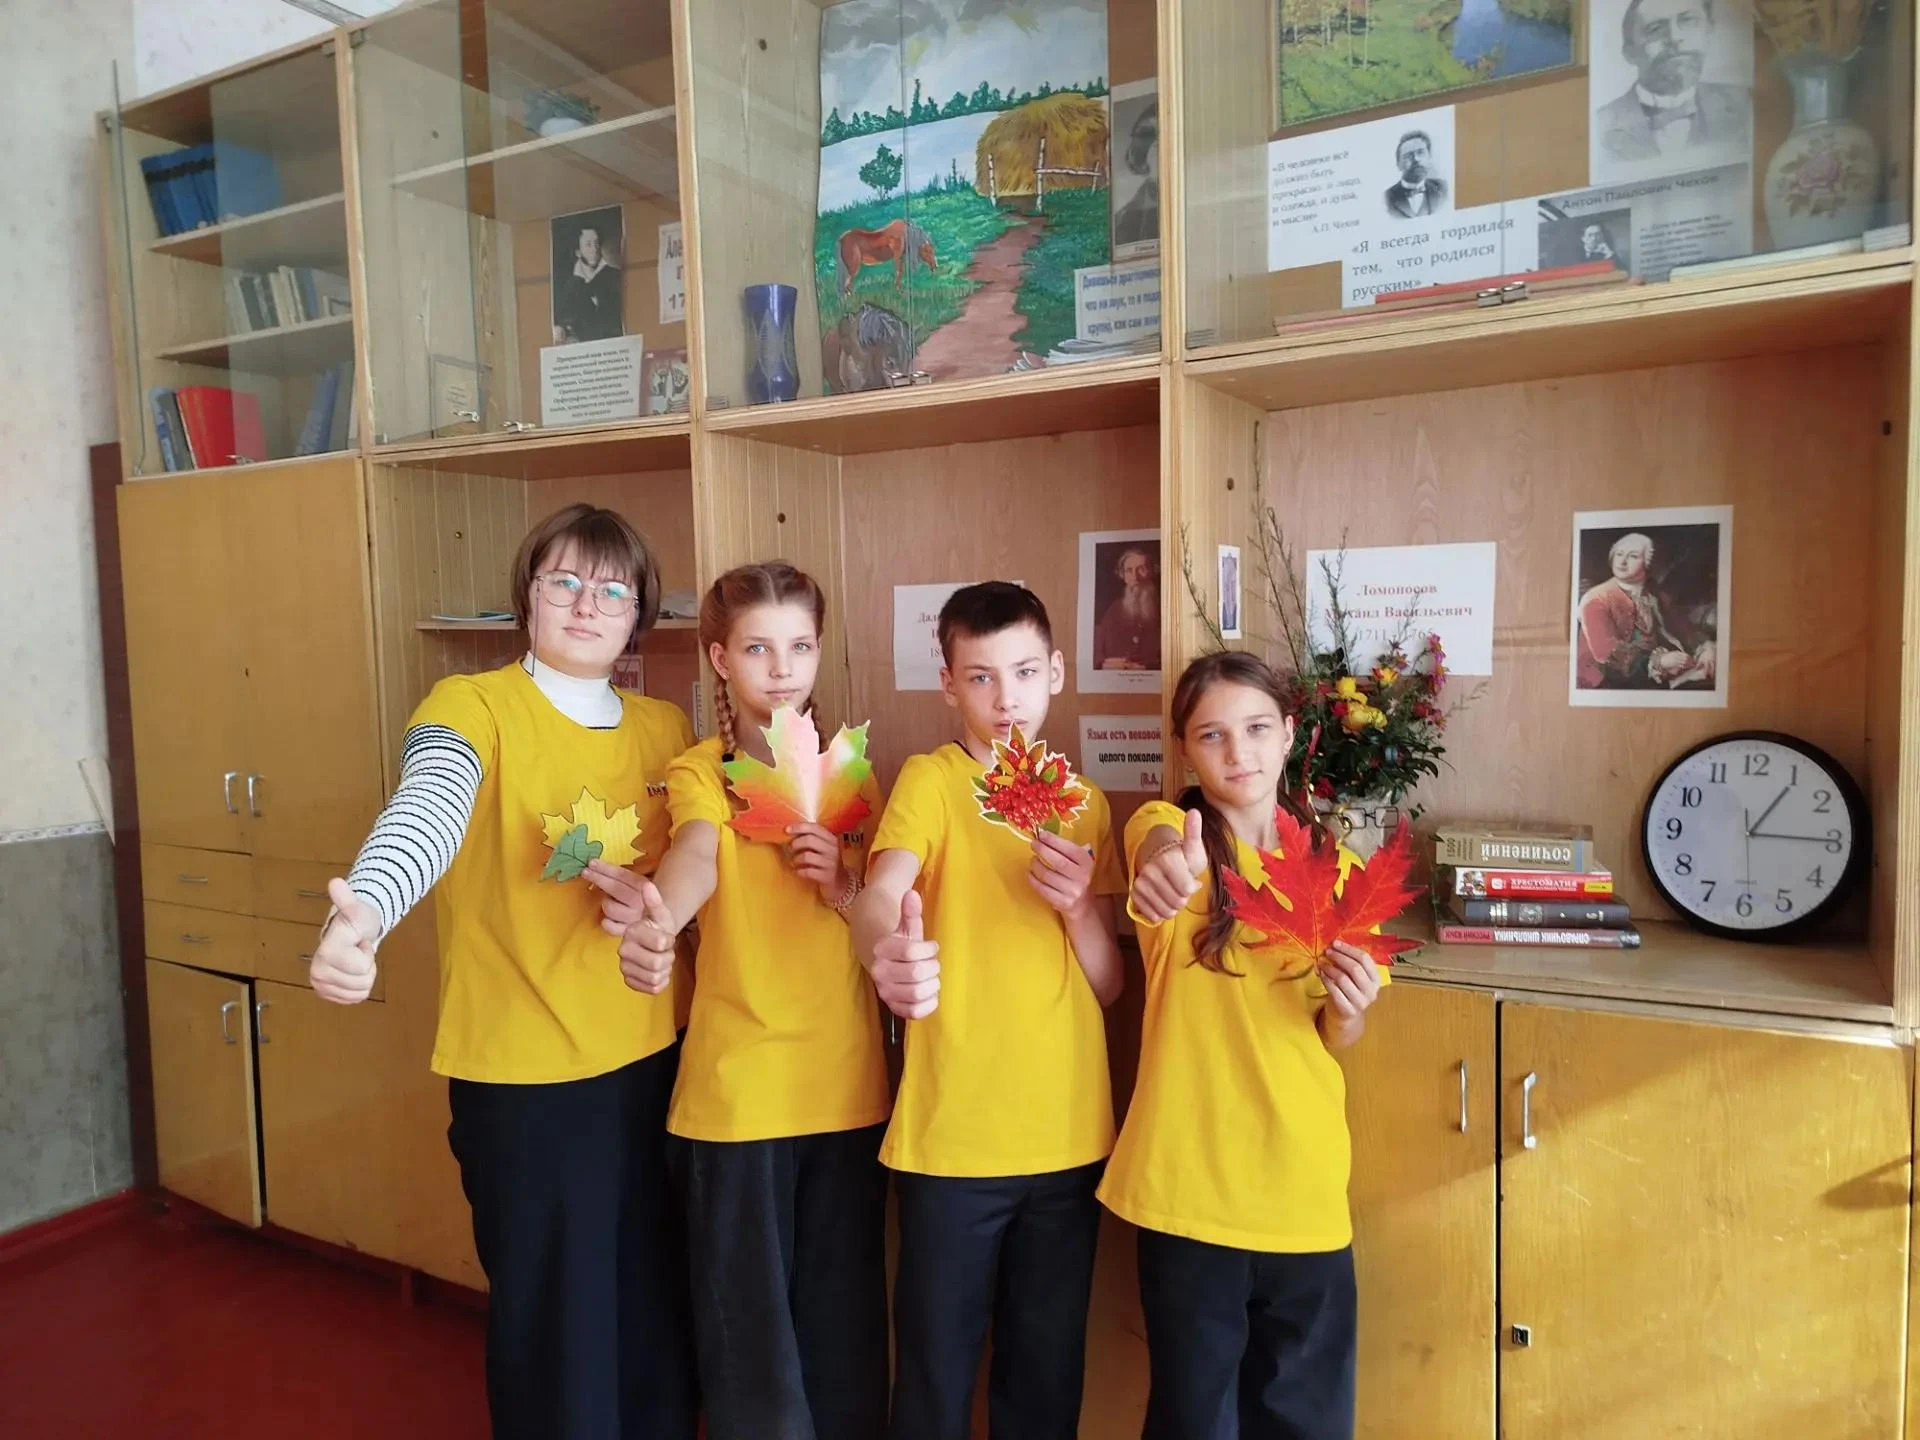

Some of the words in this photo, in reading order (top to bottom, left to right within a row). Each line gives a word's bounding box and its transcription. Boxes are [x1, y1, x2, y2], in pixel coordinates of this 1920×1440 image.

[1562, 196, 1603, 211] Антон
[1604, 183, 1673, 203] Павлович
[1675, 174, 1720, 189] Чехов
[1352, 240, 1370, 254] «Я
[1380, 233, 1431, 250] всегда
[1441, 218, 1515, 241] гордился
[1396, 255, 1424, 269] что
[1430, 243, 1496, 268] родился
[1352, 279, 1423, 301] русским»
[1114, 319, 1128, 331] как
[1356, 583, 1438, 597] Ломоносов
[1384, 606, 1473, 618] Васильевич
[1087, 728, 1108, 741] Язык
[1109, 730, 1127, 741] есть
[1098, 752, 1126, 766] целого
[1742, 753, 1770, 777] 12
[1708, 763, 1728, 784] 11
[1788, 764, 1799, 787] 1
[1680, 786, 1702, 808] 10
[1812, 789, 1832, 813] 2
[1666, 817, 1683, 840] 9
[1824, 829, 1843, 854] 3
[1674, 853, 1693, 876] 8
[1806, 864, 1825, 889] 4
[1700, 880, 1717, 902] 7
[1775, 889, 1793, 913] 5
[1736, 893, 1753, 918] 6
[1494, 930, 1540, 943] ШКОЛЬНИКА
[1541, 931, 1590, 945] СПРАВОЧНИК
